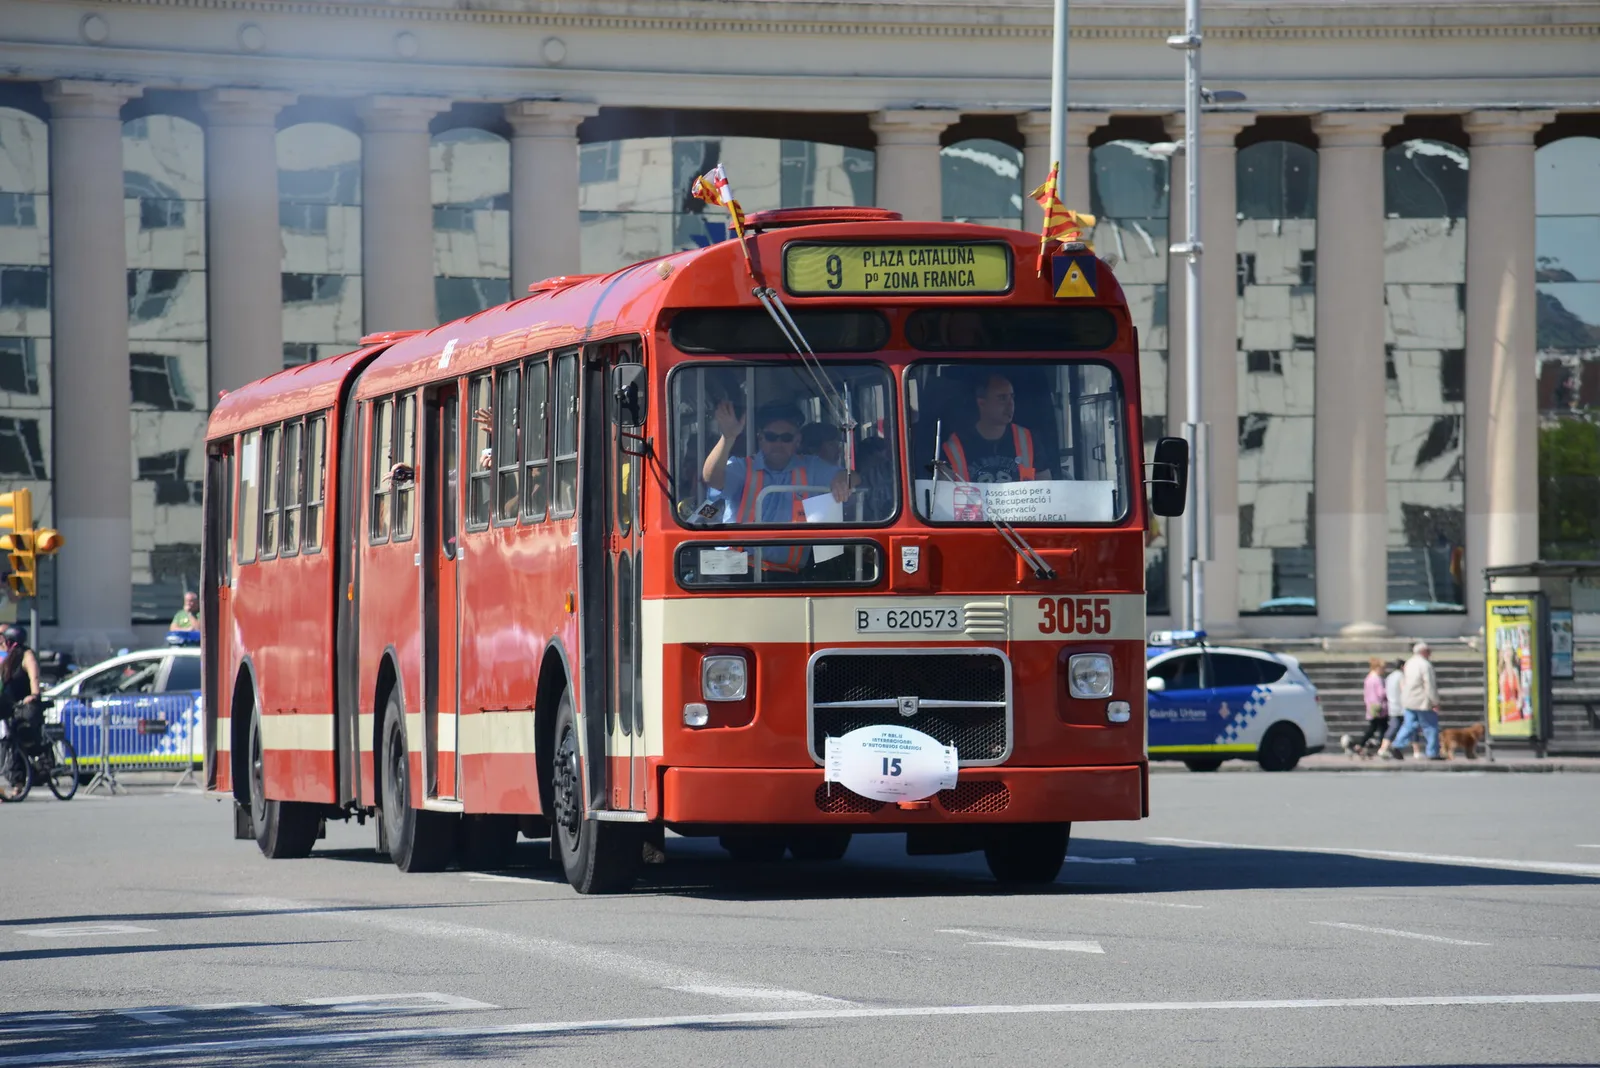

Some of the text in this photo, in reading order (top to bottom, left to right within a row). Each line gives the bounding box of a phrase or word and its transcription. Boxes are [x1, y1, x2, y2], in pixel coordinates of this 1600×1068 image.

[863, 245, 976, 268] PLAZA CATALUÑA
[825, 254, 843, 290] 9
[883, 272, 920, 290] ZONA
[923, 270, 976, 288] FRANCA
[985, 487, 1028, 497] Associació
[1029, 488, 1043, 496] per
[985, 497, 993, 506] la
[995, 495, 1047, 506] Recuperació
[986, 505, 1037, 514] Conservació
[1037, 597, 1111, 635] 3055
[883, 757, 902, 776] 15
